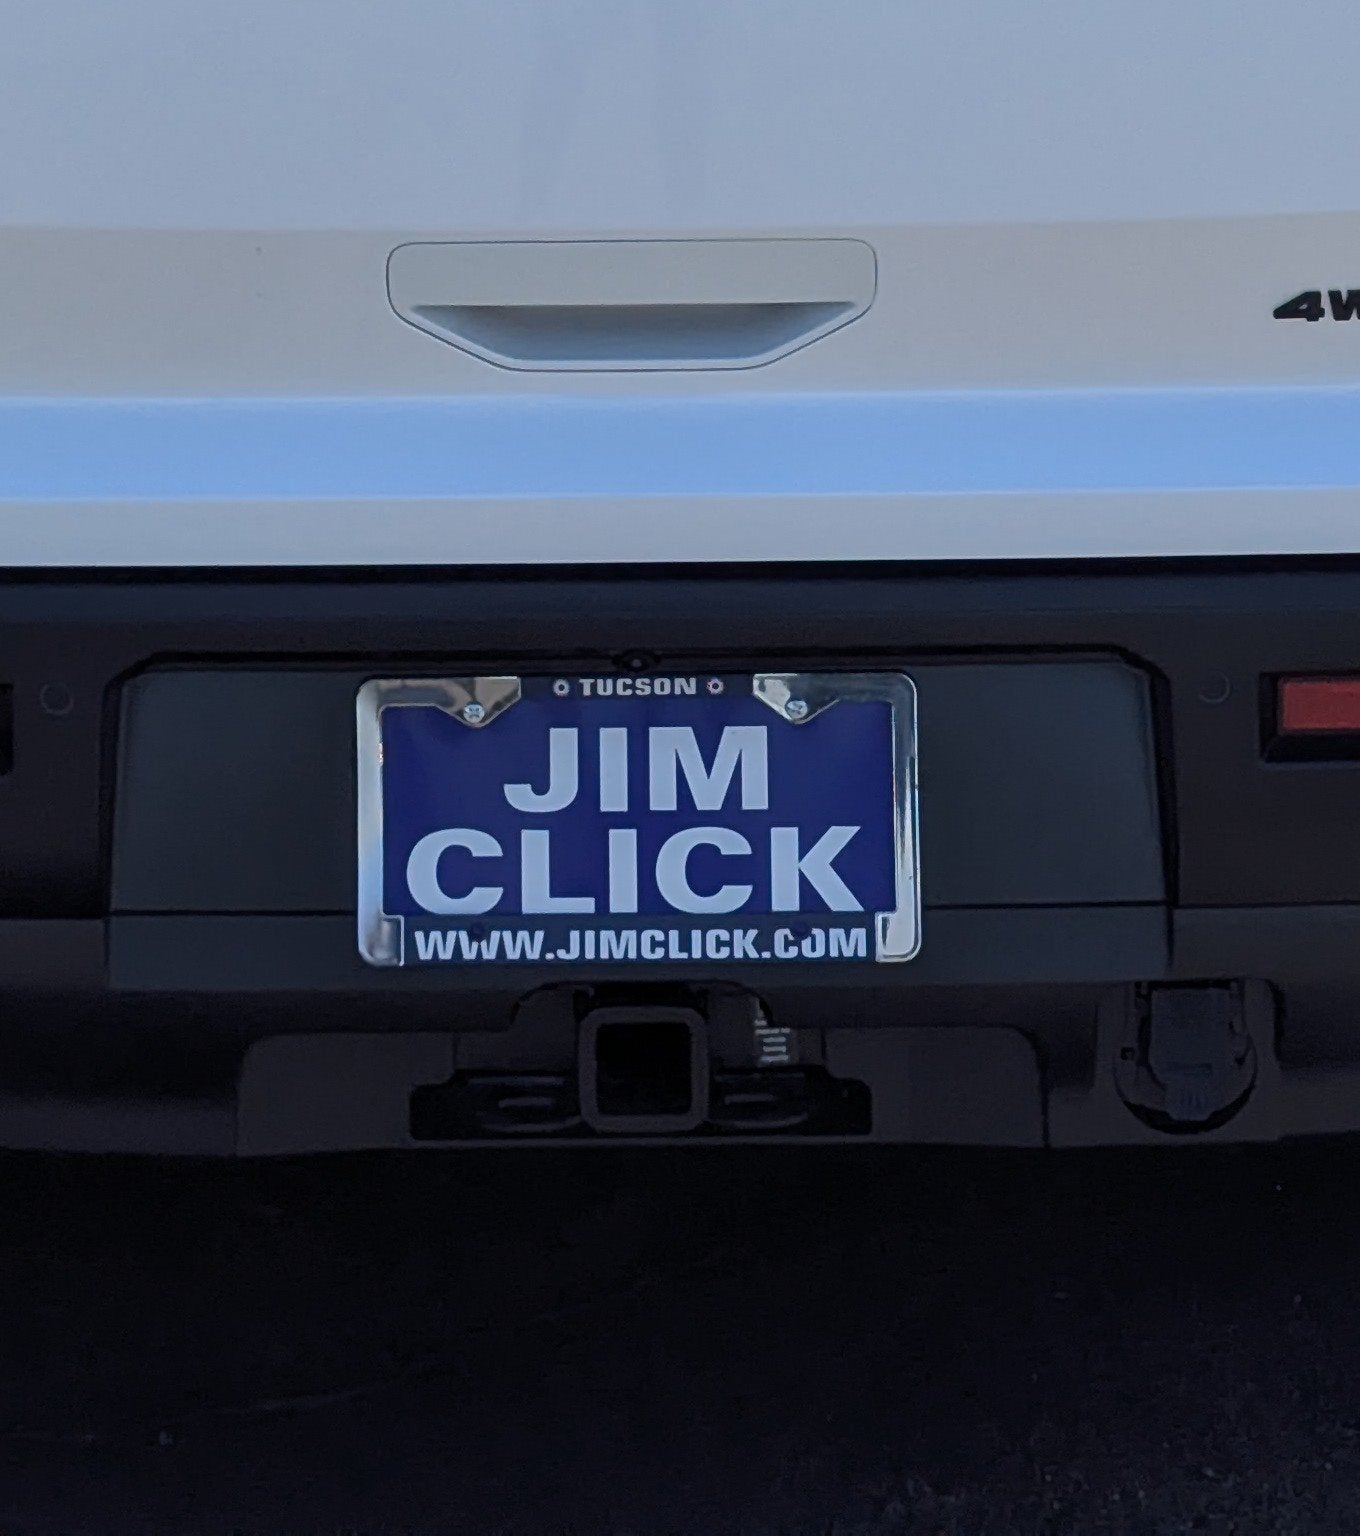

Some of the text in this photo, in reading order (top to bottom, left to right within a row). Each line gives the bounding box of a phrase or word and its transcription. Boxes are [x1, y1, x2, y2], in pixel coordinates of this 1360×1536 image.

[578, 676, 698, 698] TUCSON
[503, 725, 769, 814] JIM
[405, 825, 865, 916] CLICK
[414, 927, 868, 961] WWW.JIMCLICK.COM
